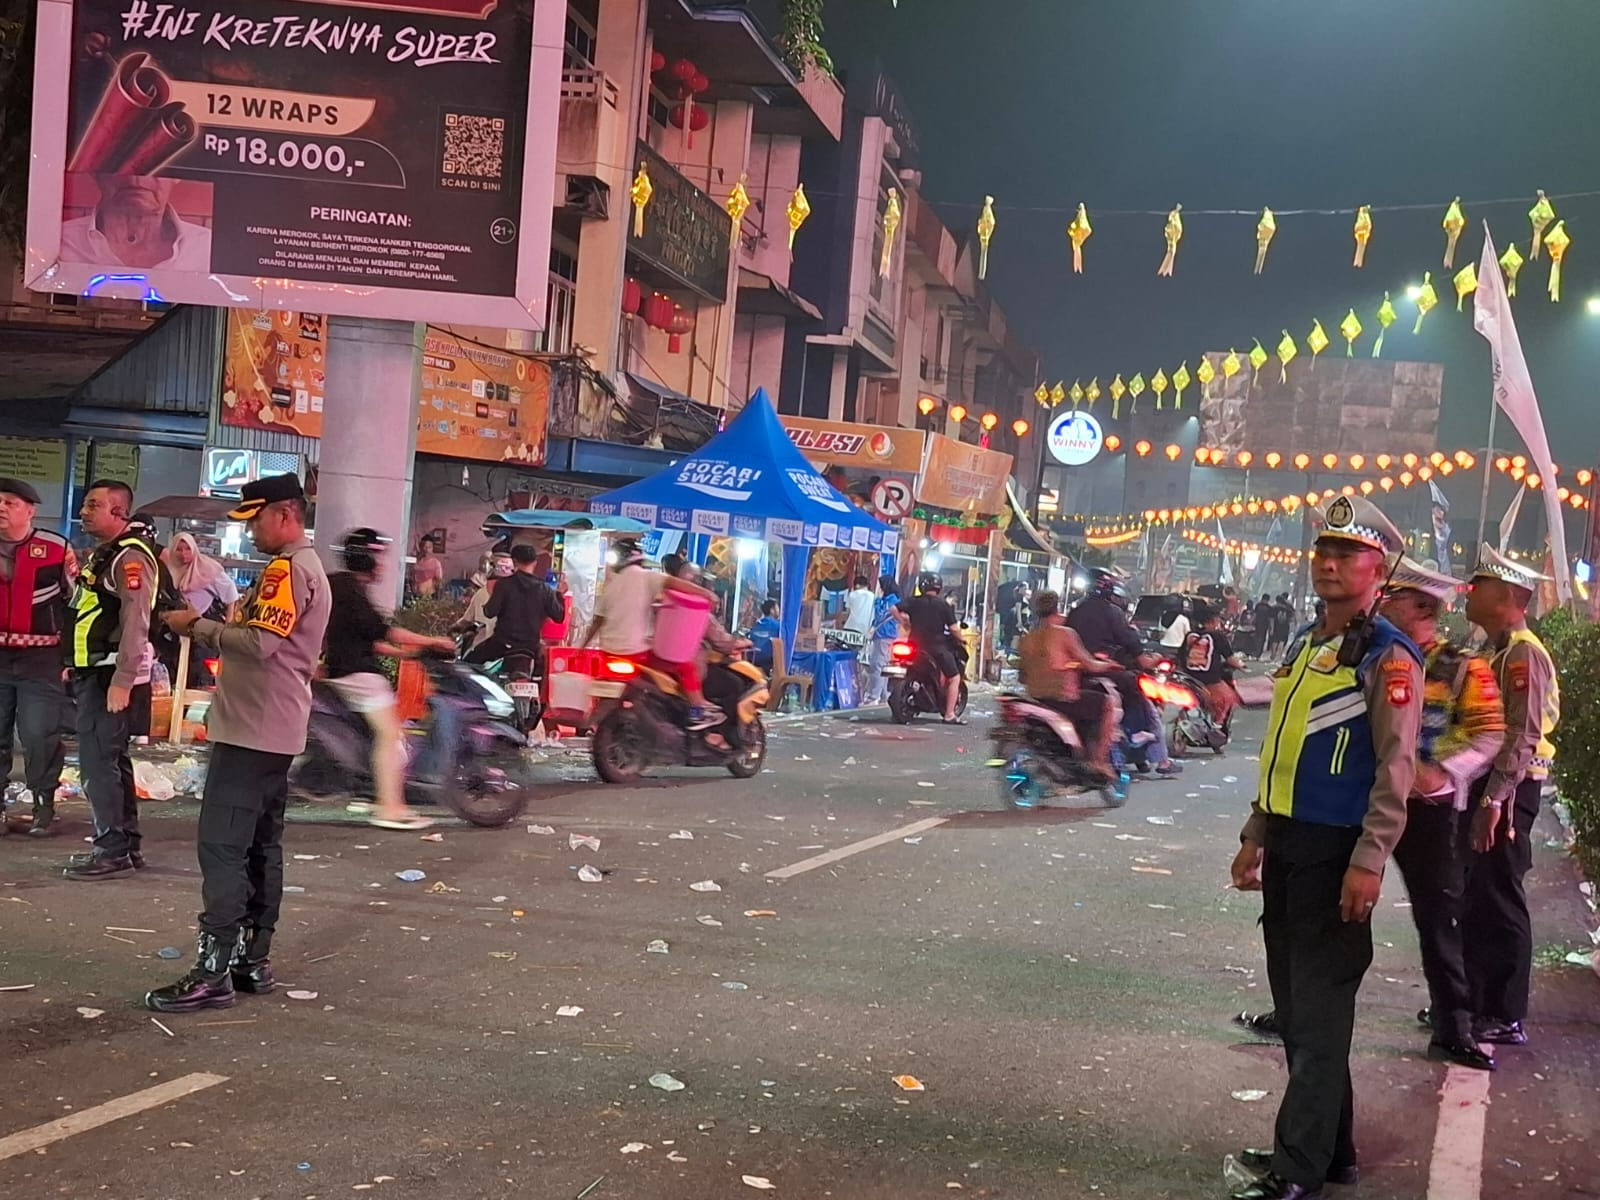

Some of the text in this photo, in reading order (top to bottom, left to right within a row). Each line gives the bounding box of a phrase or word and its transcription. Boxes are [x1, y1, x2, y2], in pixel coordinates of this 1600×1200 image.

[120, 0, 201, 41] #INI
[386, 26, 500, 66] SUPER
[207, 93, 339, 125] 12 WRAPS
[205, 134, 365, 177] Rp 18.000,-
[441, 178, 501, 191] SCAN DI SINI
[310, 206, 412, 227] PERINGATAN:
[246, 226, 472, 253] KARENA MEROKOK, SAYA TERKENA KANKER TENGGOROKAN.
[493, 225, 514, 236] 21+
[273, 238, 310, 247] LAYANAN
[311, 241, 349, 250] BERHENTI
[350, 244, 389, 254] MEROKOK
[258, 258, 286, 267] ORANG
[297, 262, 325, 271] BAWAH
[337, 265, 363, 273] TAHUN
[384, 268, 431, 280] PEREMPUAN
[432, 273, 458, 282] HAMIL.
[275, 251, 440, 272] DILARANG MENJUAL DAN MEMBERI KEPADA
[1054, 438, 1096, 449] WINNY
[677, 472, 749, 489] SWEAT
[683, 462, 762, 481] POCARI
